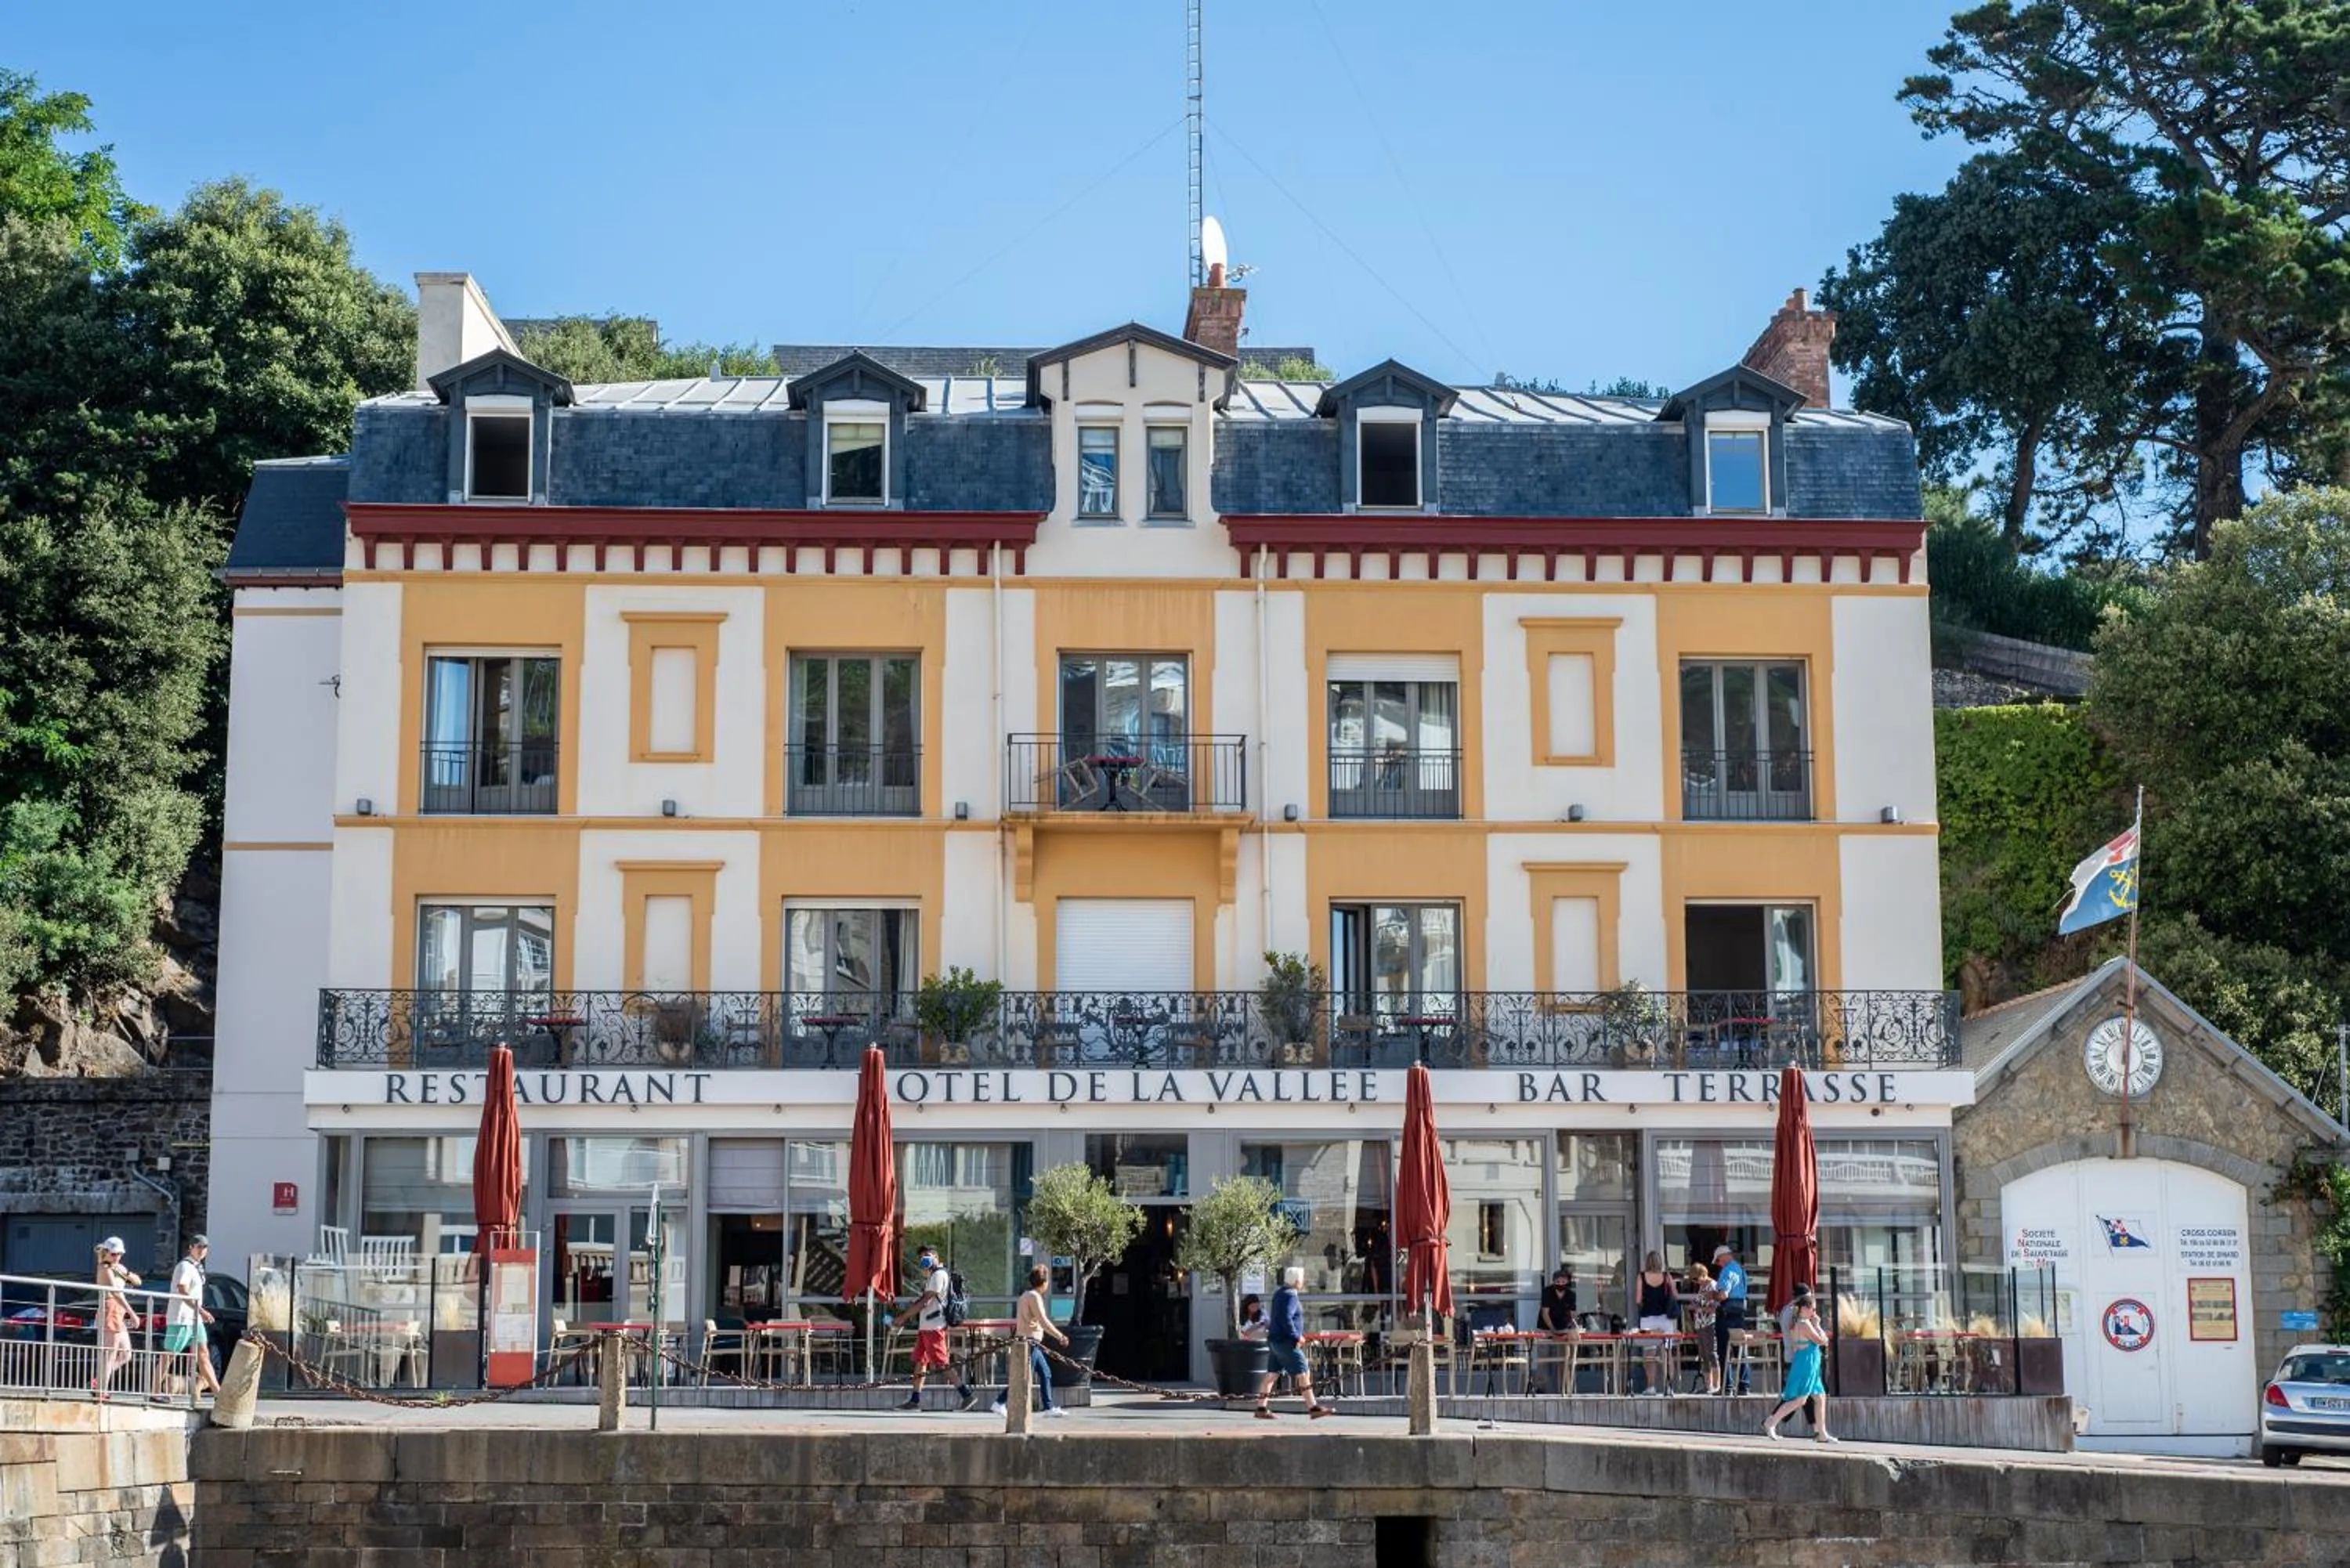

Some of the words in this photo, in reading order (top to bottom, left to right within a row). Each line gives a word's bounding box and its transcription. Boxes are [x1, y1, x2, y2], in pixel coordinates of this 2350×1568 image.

[855, 1072, 1021, 1102] OTEL
[1048, 1072, 1106, 1102] DE
[1132, 1072, 1184, 1102] LA
[1207, 1072, 1376, 1102] VALLEE
[1518, 1073, 1607, 1102] BAR
[284, 1187, 294, 1197] H
